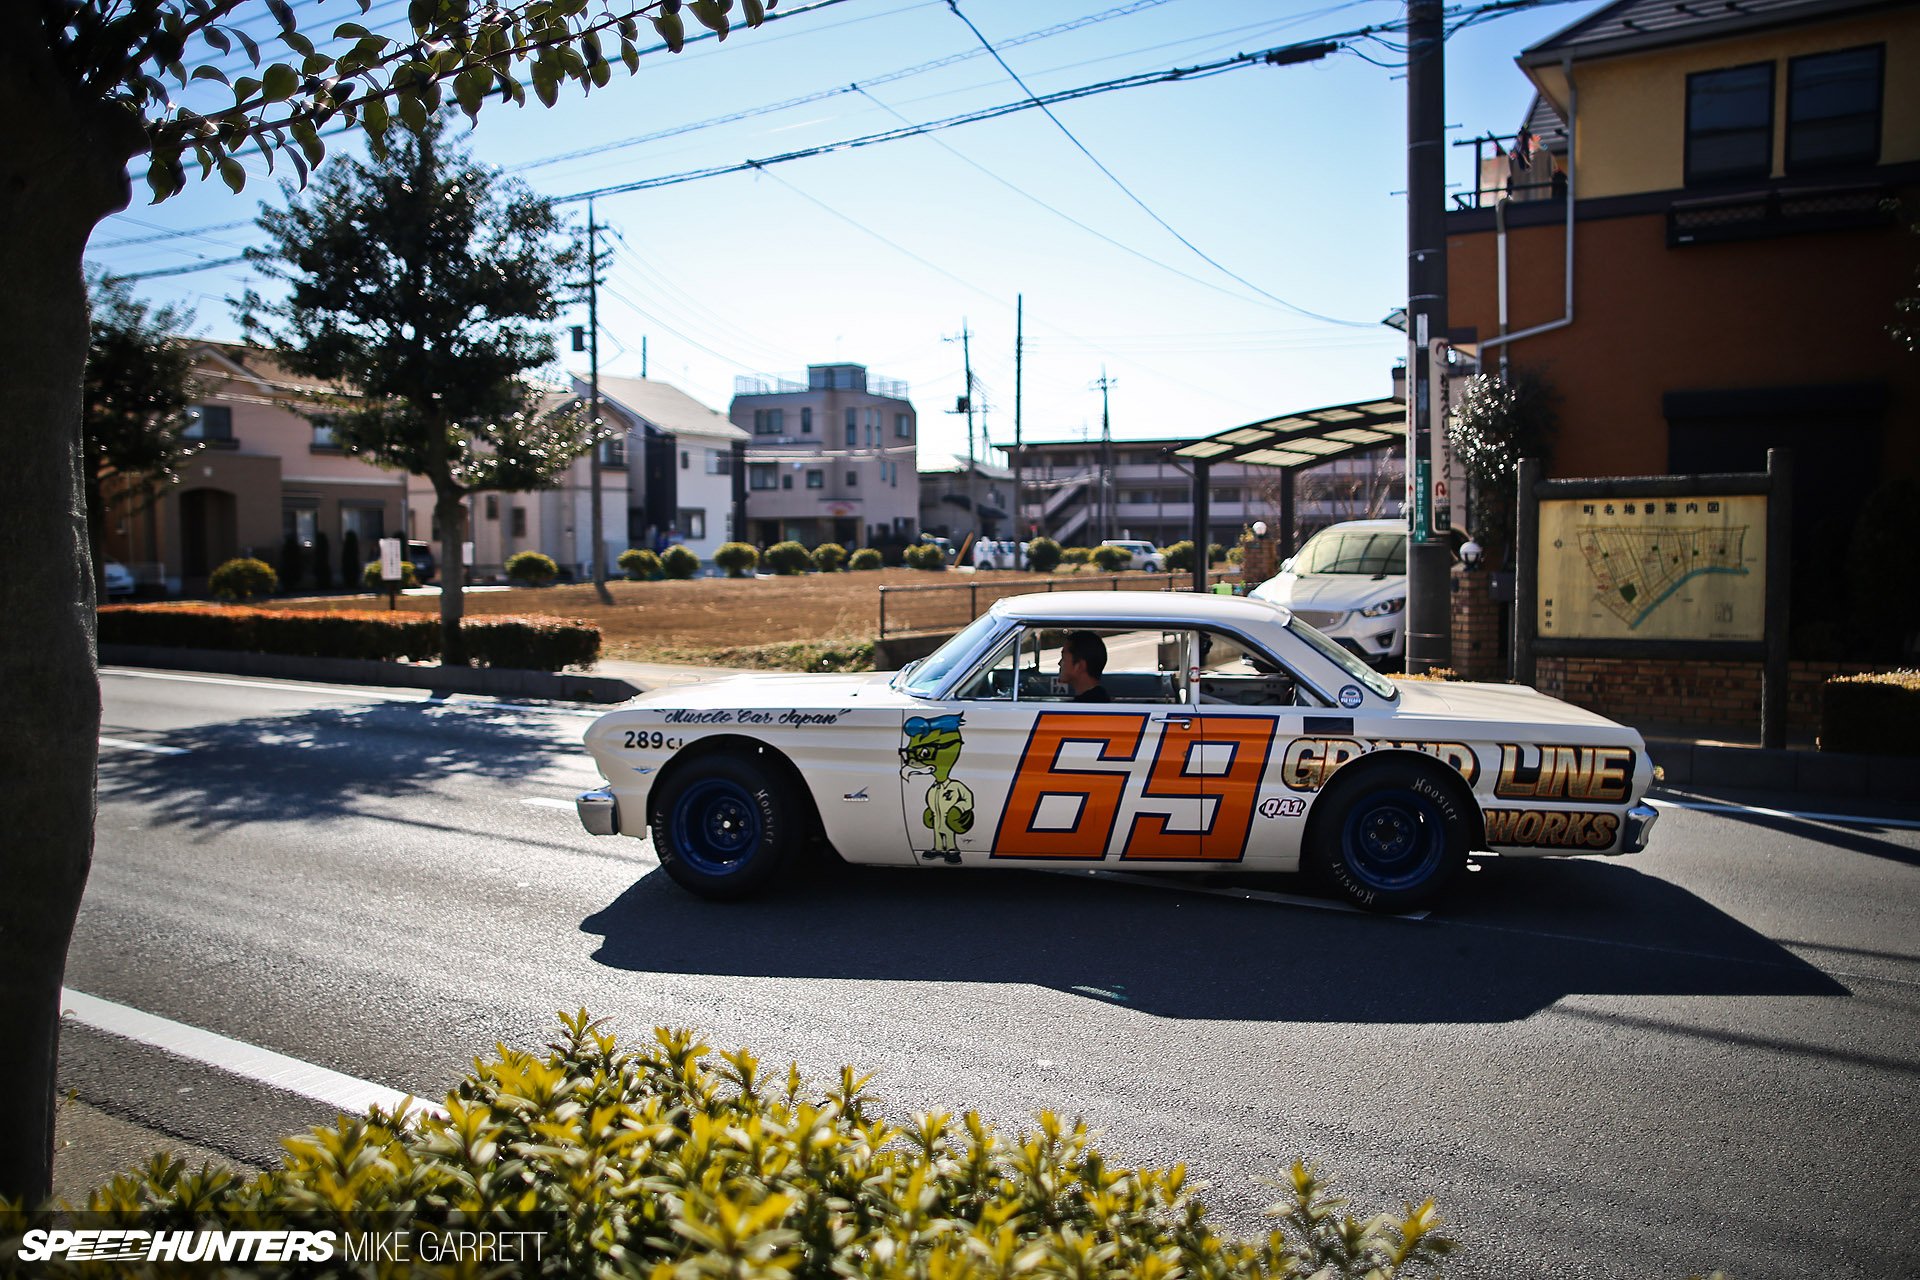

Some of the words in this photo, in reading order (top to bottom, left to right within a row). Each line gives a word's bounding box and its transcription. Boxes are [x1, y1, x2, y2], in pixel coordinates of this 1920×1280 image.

[1583, 501, 1720, 516] 町名地番案内図
[737, 709, 772, 724] Car
[624, 730, 663, 749] 289
[989, 710, 1280, 863] 69
[1282, 737, 1481, 793] GRD
[1494, 743, 1636, 804] LINE
[754, 789, 776, 846] Hoosier
[1263, 798, 1302, 818] QA1
[1411, 777, 1458, 821] Hoosier
[1483, 808, 1620, 850] WORKS
[1332, 861, 1376, 904] Hoosier
